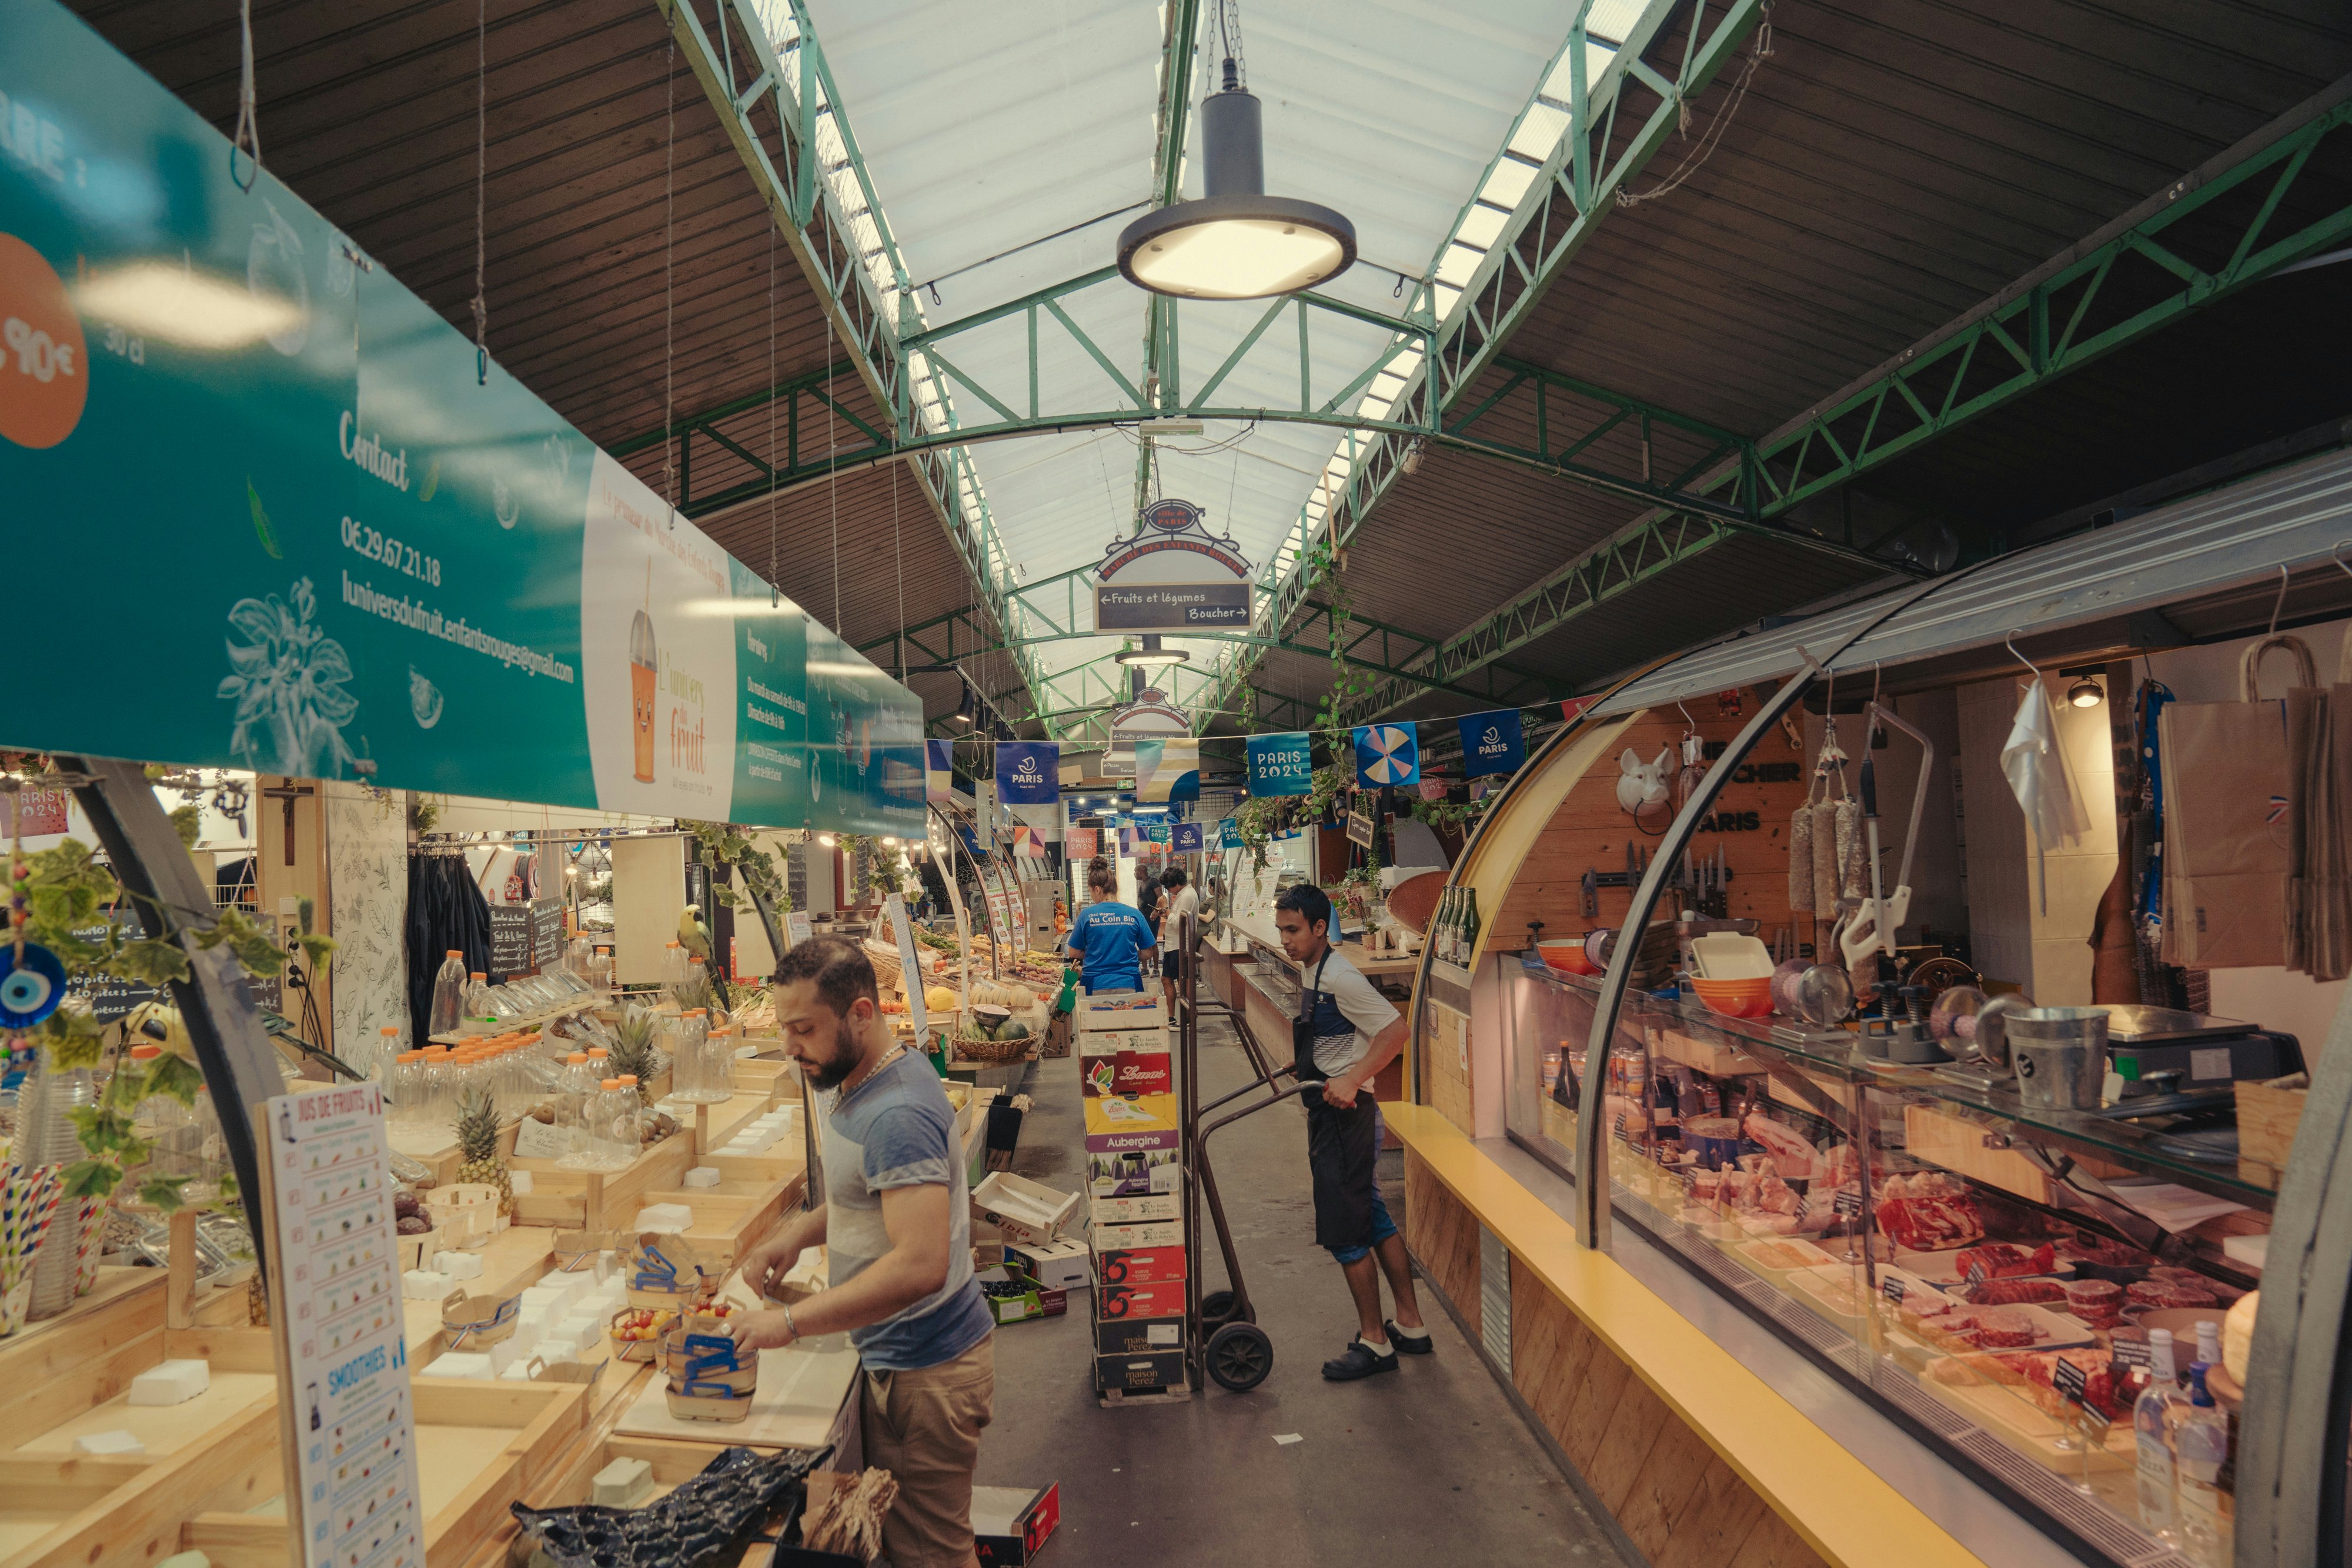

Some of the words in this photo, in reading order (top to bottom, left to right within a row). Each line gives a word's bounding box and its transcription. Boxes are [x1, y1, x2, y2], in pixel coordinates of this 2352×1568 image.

[339, 410, 409, 492] Contact
[340, 516, 441, 587] 06.29.67.21.18
[1102, 547, 1140, 578] MARCHÉ
[1142, 542, 1161, 554] DES
[1164, 541, 1207, 553] ENFANTS
[1208, 548, 1243, 576] ROUGES
[1112, 593, 1142, 603] Fruits
[1147, 593, 1158, 603] et
[1162, 592, 1205, 606] légumes
[1189, 607, 1235, 620] Boucher
[343, 569, 573, 684] luniversdufruit.enfantsrouges@gmail.com
[670, 707, 705, 775] fruit
[1478, 743, 1508, 754] PARIS
[1258, 751, 1301, 764] PARIS
[1259, 765, 1301, 778] 2024
[1012, 774, 1043, 783] PARIS
[1424, 784, 1441, 793] 202
[92, 1007, 126, 1018] pièces
[1120, 1065, 1165, 1080] Lucas
[298, 1097, 316, 1122] JUS
[318, 1095, 331, 1118] DE
[332, 1089, 366, 1115] FRUITS
[1107, 1136, 1160, 1148] Aubergine
[1102, 1275, 1107, 1283] LA
[1128, 1343, 1152, 1351] Perez
[328, 1345, 386, 1397] SMOOTHIES
[1125, 1369, 1158, 1379] maison
[1130, 1377, 1155, 1386] Perez
